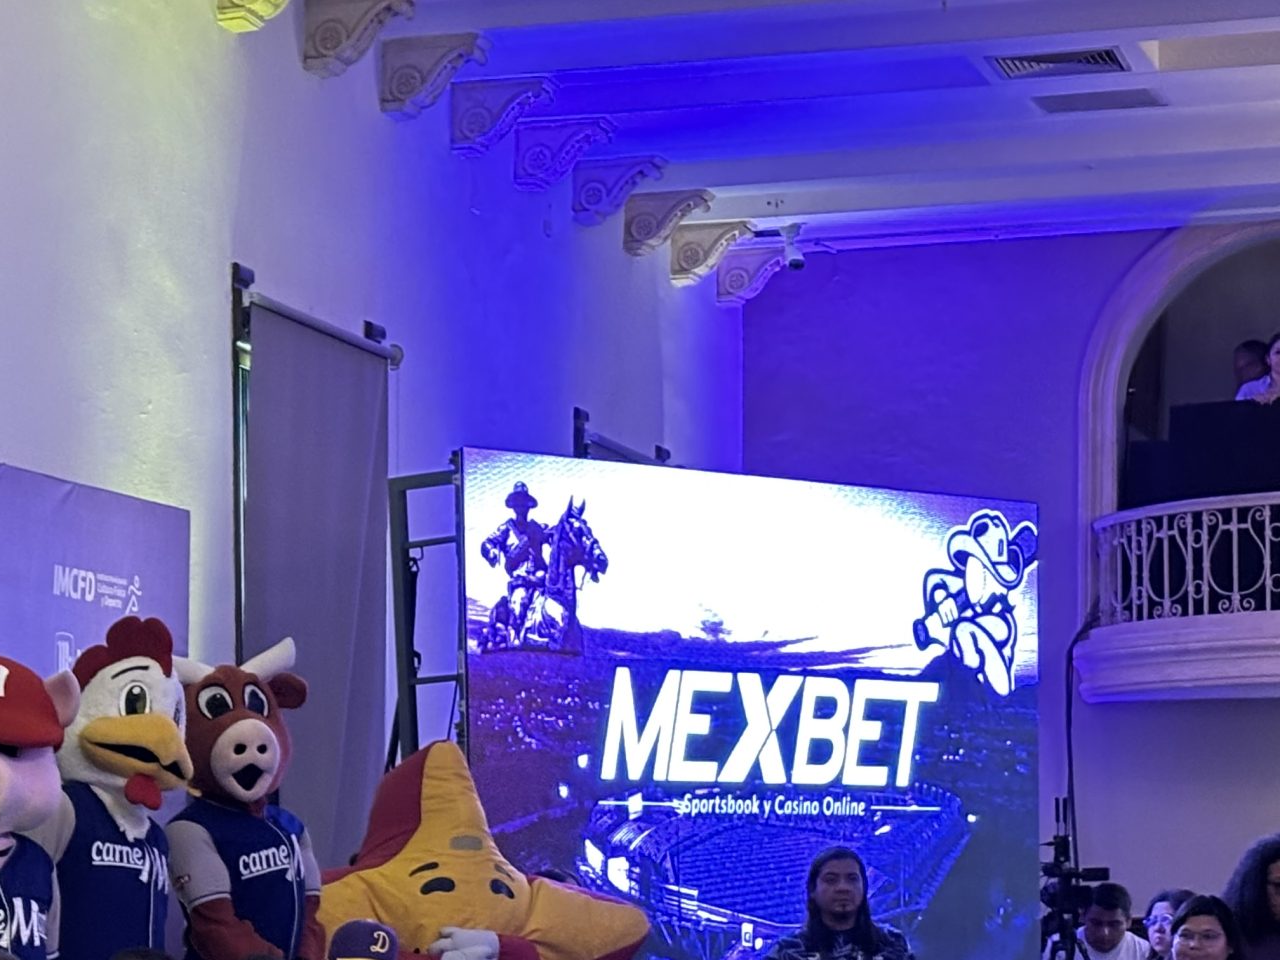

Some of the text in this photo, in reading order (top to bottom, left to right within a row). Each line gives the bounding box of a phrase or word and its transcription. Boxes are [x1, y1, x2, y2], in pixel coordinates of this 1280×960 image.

[53, 564, 95, 602] IMCFD
[600, 666, 940, 787] MEXBET
[684, 793, 866, 819] Sportsbook y Casino Online
[370, 930, 390, 954] D
